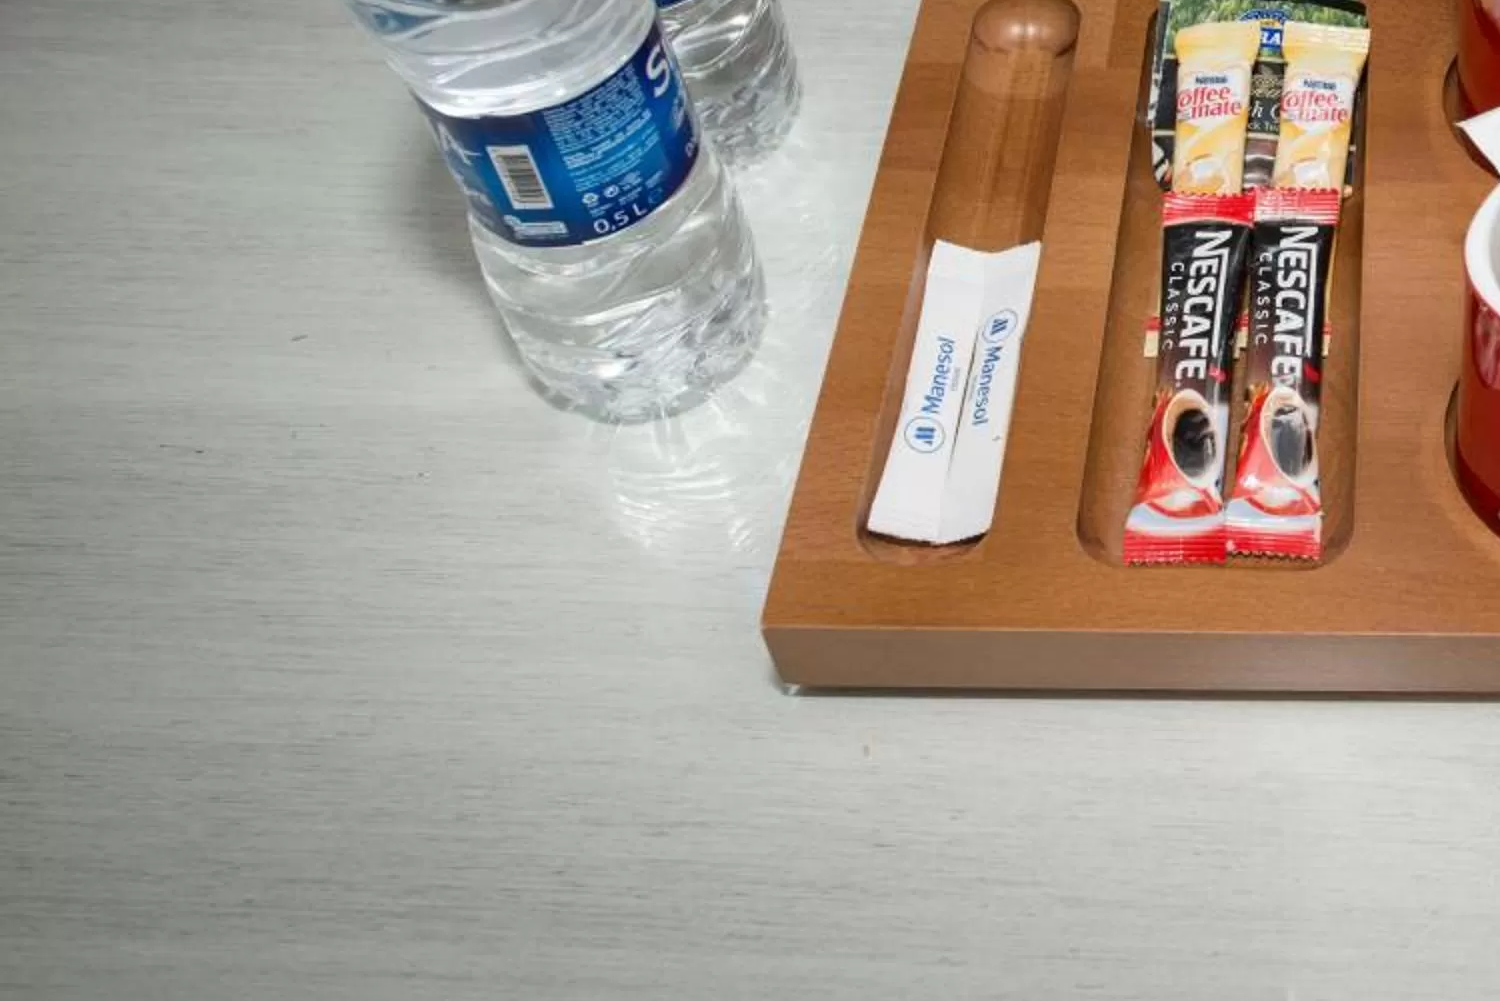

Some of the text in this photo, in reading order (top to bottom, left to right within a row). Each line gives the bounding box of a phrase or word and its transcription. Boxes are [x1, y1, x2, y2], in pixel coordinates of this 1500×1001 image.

[632, 203, 648, 216] L
[1161, 261, 1186, 351] CLASSIC
[1254, 250, 1274, 346] CLASSIC
[921, 335, 956, 415] Manesol
[971, 345, 1003, 426] Manesol
